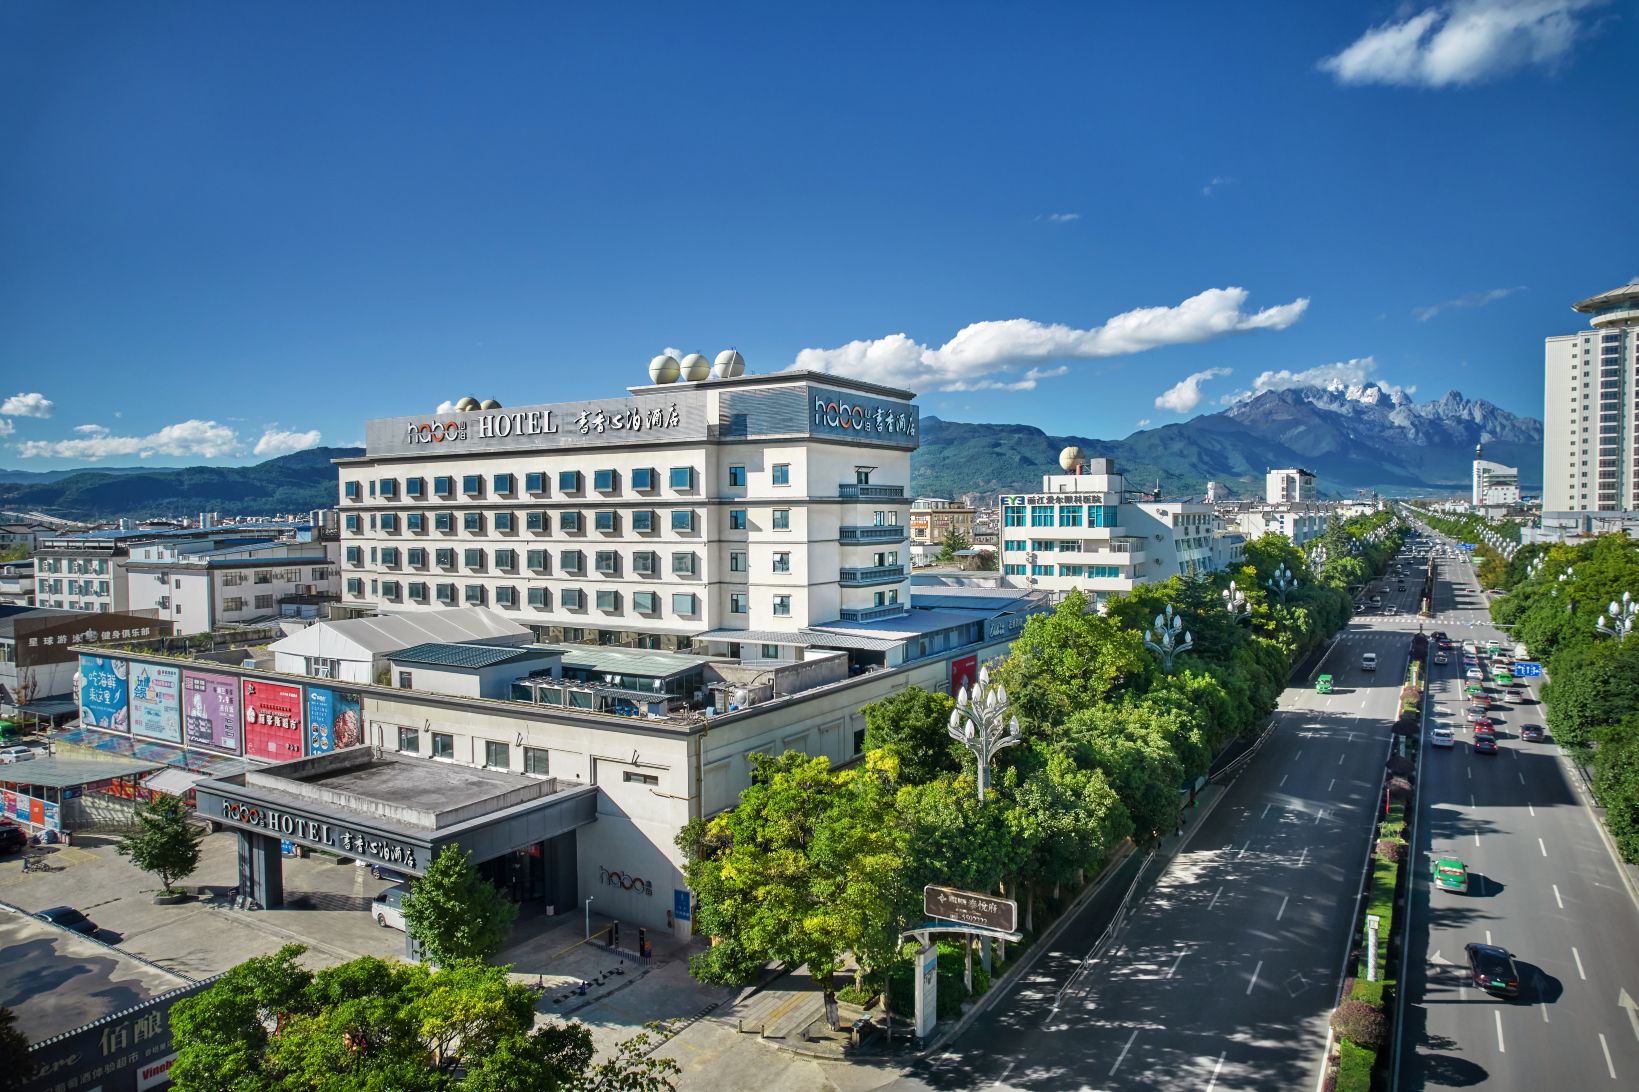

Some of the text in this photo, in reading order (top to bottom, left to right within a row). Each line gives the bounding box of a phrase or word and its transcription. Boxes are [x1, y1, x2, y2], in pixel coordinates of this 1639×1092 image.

[478, 411, 558, 438] HOTEL
[101, 627, 150, 640] 健身俱乐部
[88, 670, 117, 690] 吃海鲜
[88, 687, 111, 704] 来这里
[268, 811, 335, 846] HOTEL
